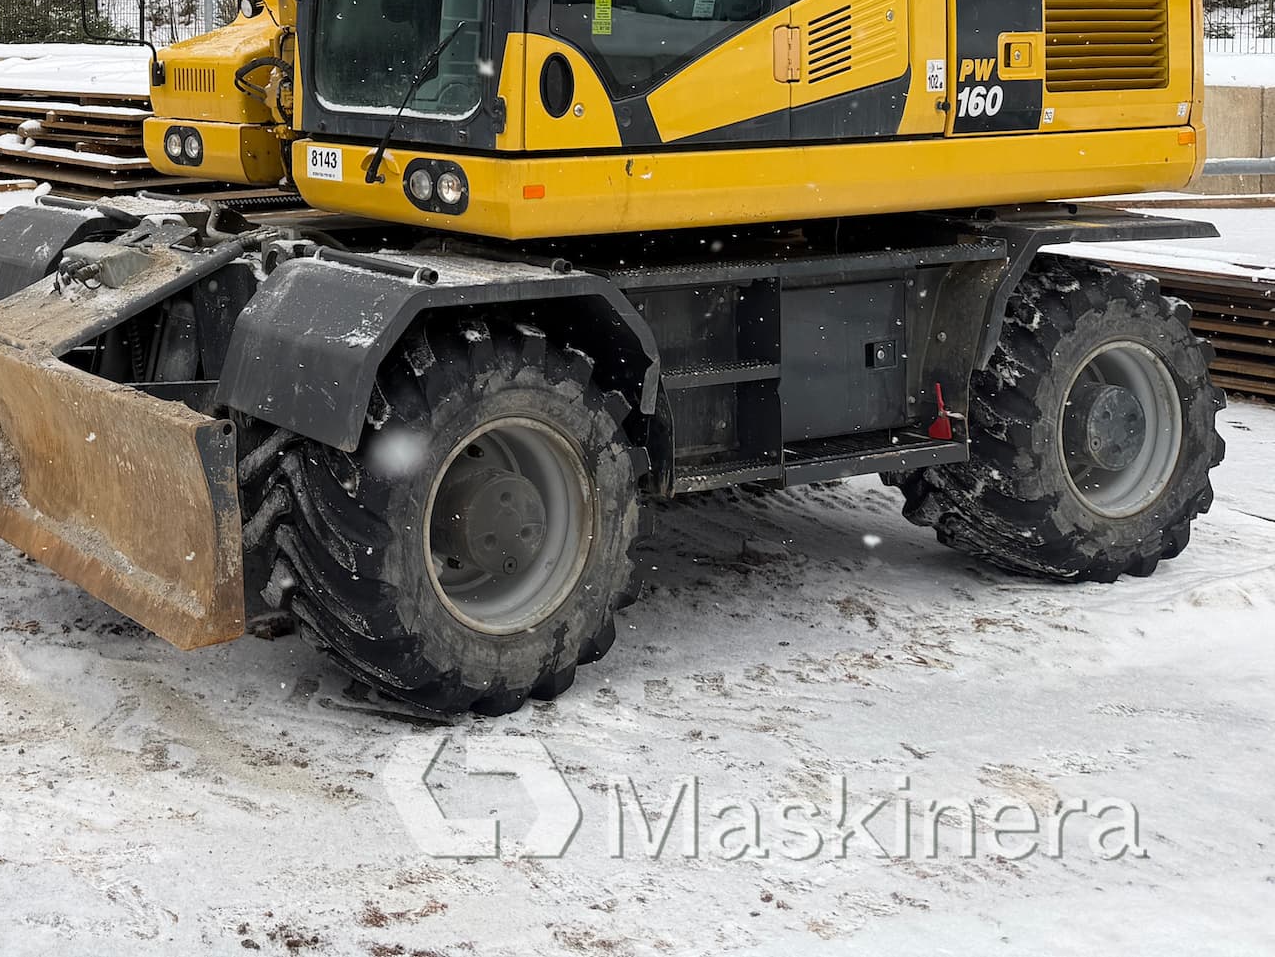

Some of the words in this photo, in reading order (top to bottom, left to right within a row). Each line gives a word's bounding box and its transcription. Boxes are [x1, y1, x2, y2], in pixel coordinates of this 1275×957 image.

[958, 58, 996, 82] PW
[928, 74, 939, 90] 102
[958, 85, 1003, 117] 160
[311, 149, 337, 169] 8143
